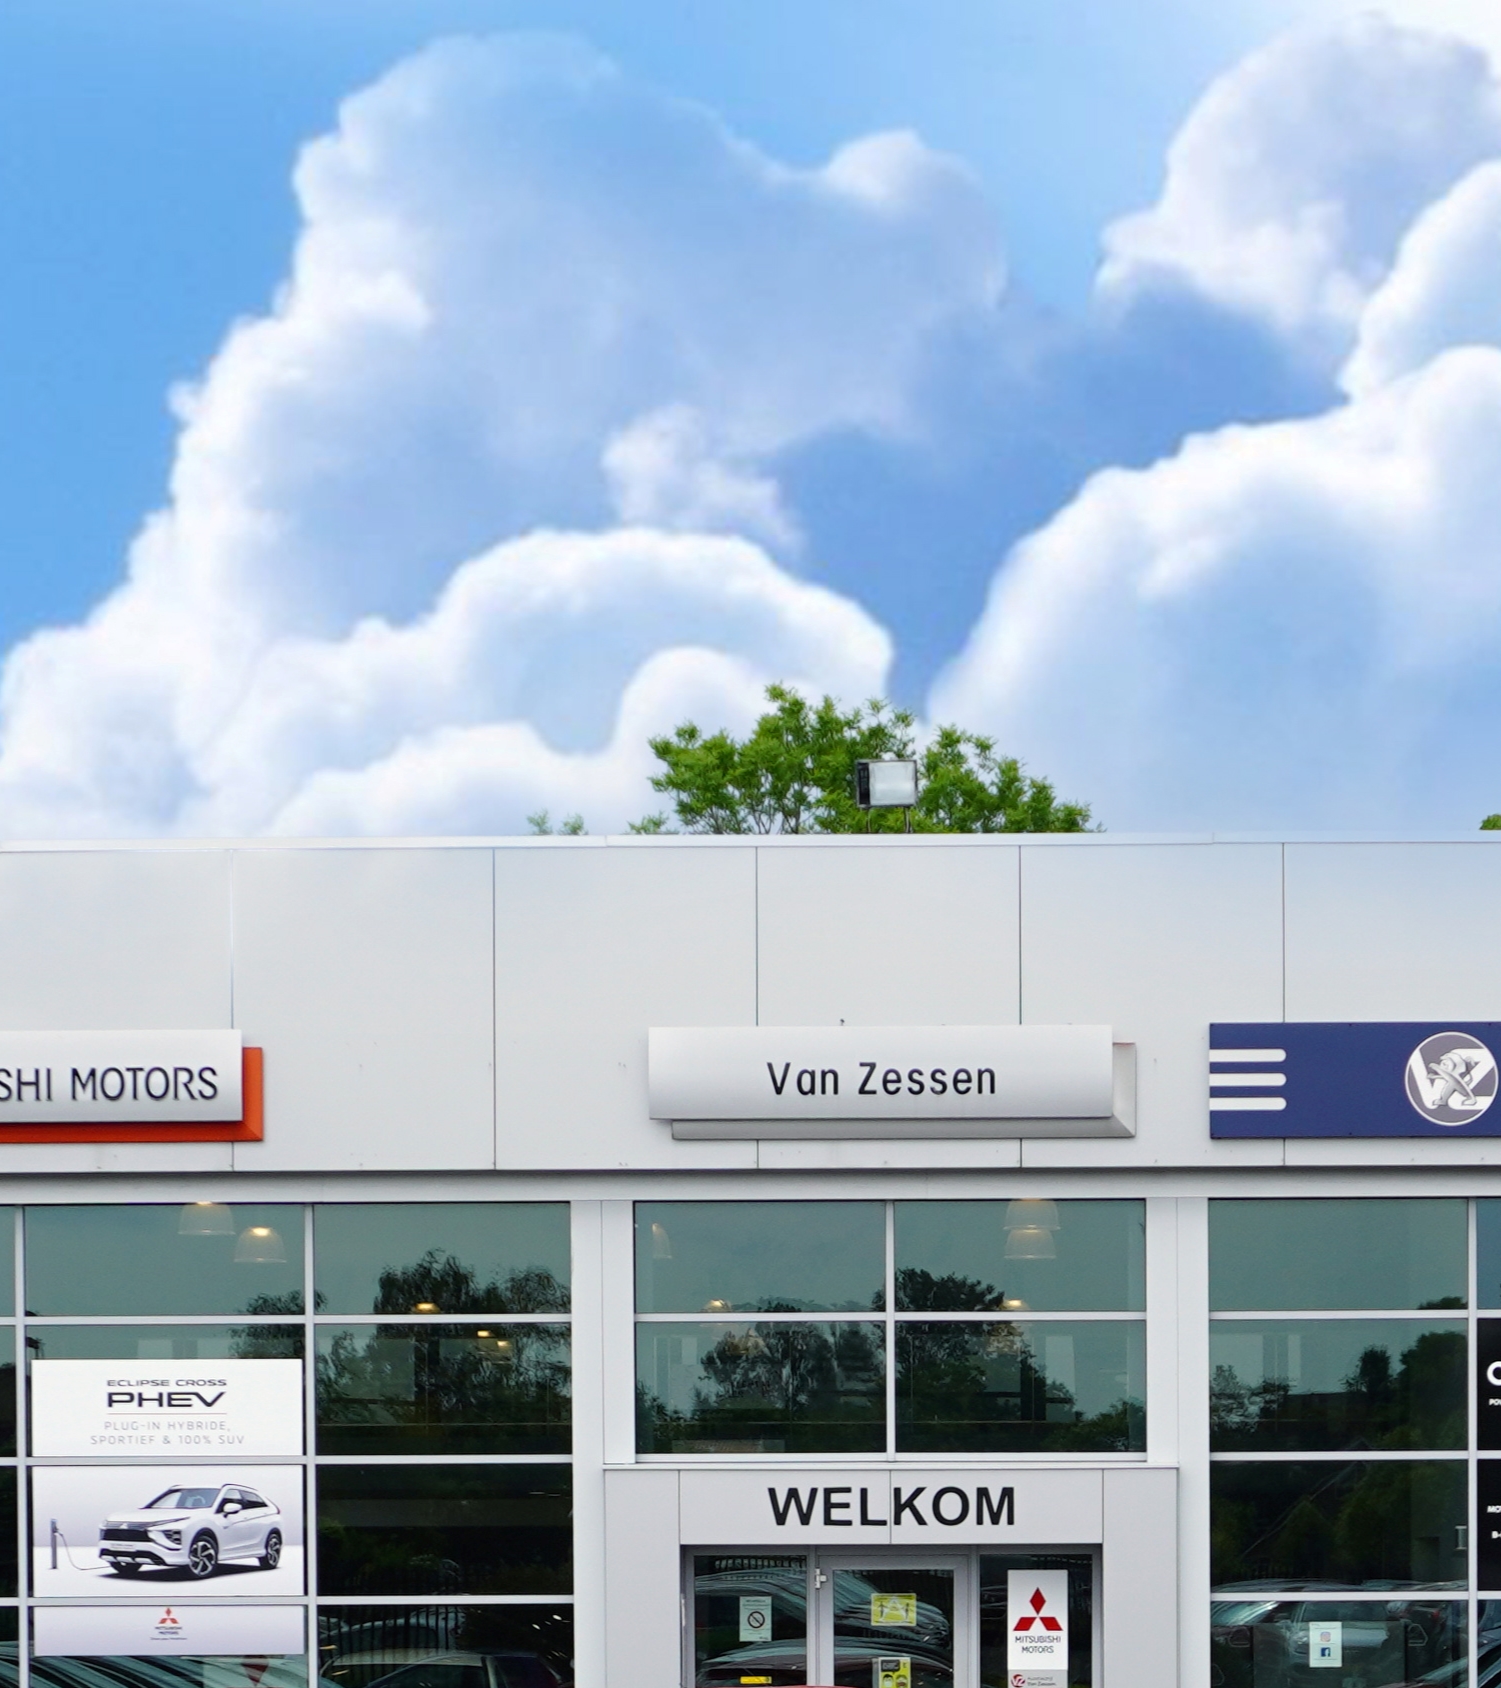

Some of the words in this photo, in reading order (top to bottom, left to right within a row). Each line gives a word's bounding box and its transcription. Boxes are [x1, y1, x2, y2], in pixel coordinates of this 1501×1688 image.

[766, 1062, 839, 1096] Van
[858, 1061, 997, 1096] Zessen
[71, 1067, 218, 1102] MOTORS
[107, 1379, 170, 1387] ECLIPSE
[176, 1379, 227, 1387] CROSS
[107, 1391, 226, 1408] PHEV
[104, 1421, 161, 1431] PLUG-IN
[167, 1421, 231, 1432] HYBRIDE,
[90, 1435, 155, 1445] SPORTIEF
[162, 1435, 171, 1445] &
[178, 1435, 212, 1445] 100%
[218, 1434, 245, 1445] SUV
[767, 1486, 1016, 1527] WELKOM
[1014, 1635, 1062, 1644] MITSUBISHI
[1021, 1645, 1055, 1654] MOTORS
